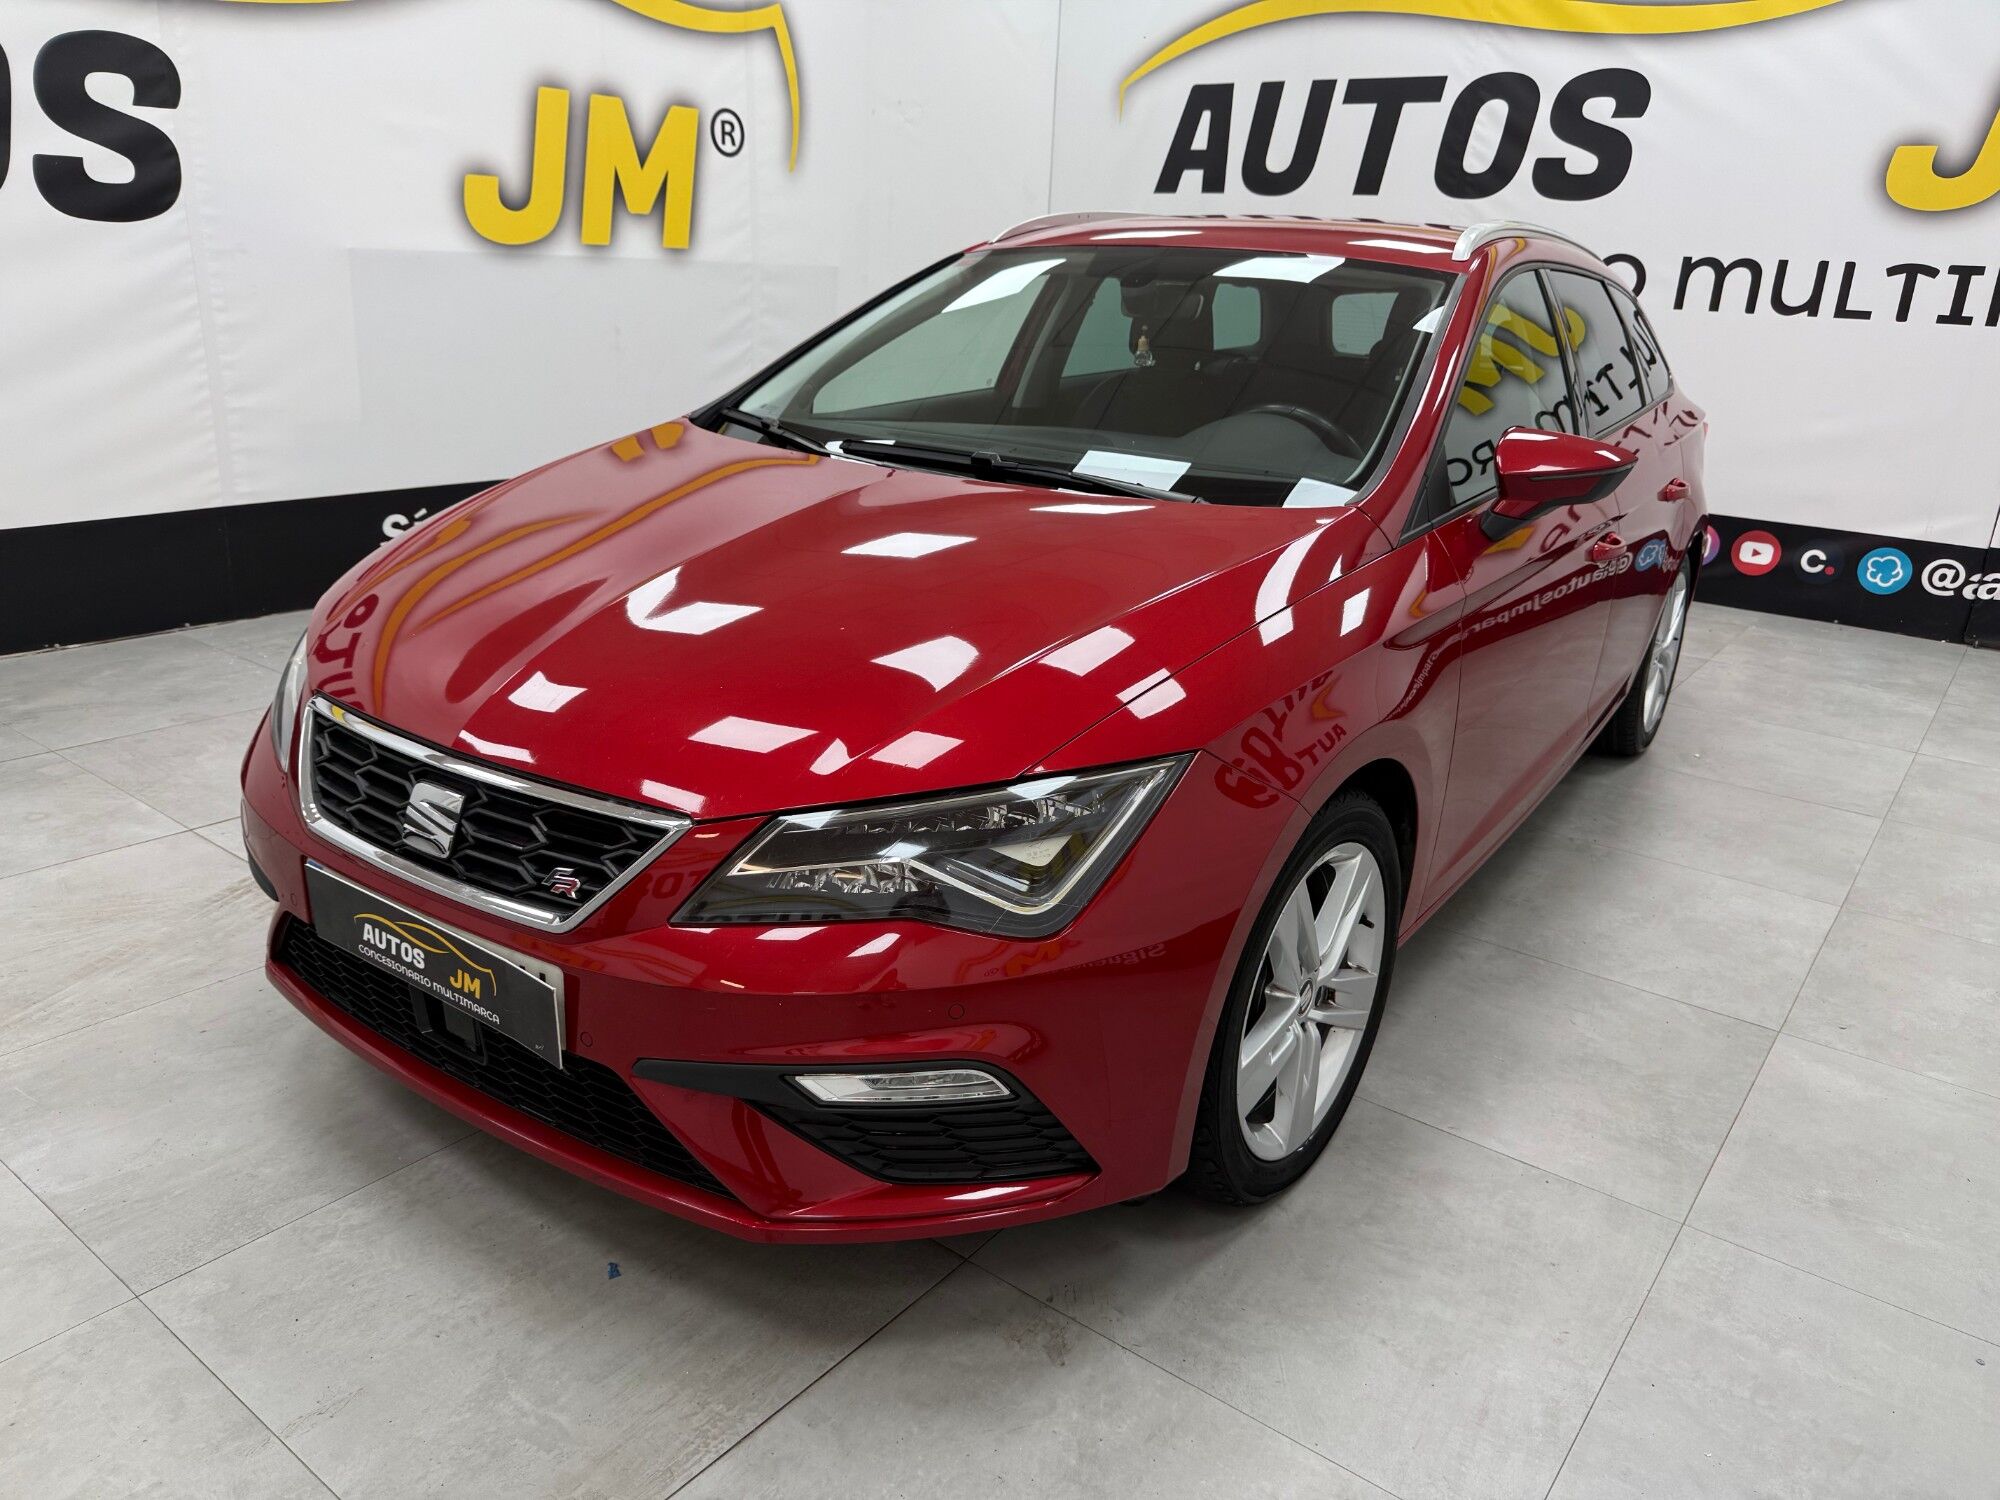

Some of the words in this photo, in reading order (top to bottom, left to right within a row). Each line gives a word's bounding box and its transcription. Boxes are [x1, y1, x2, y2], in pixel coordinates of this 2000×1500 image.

[0, 29, 182, 222] S
[1153, 67, 1652, 201] AUTOS
[1672, 255, 2000, 328] MULTI
[541, 867, 581, 899] FR
[362, 923, 426, 969] AUTOS
[449, 969, 481, 1000] JM
